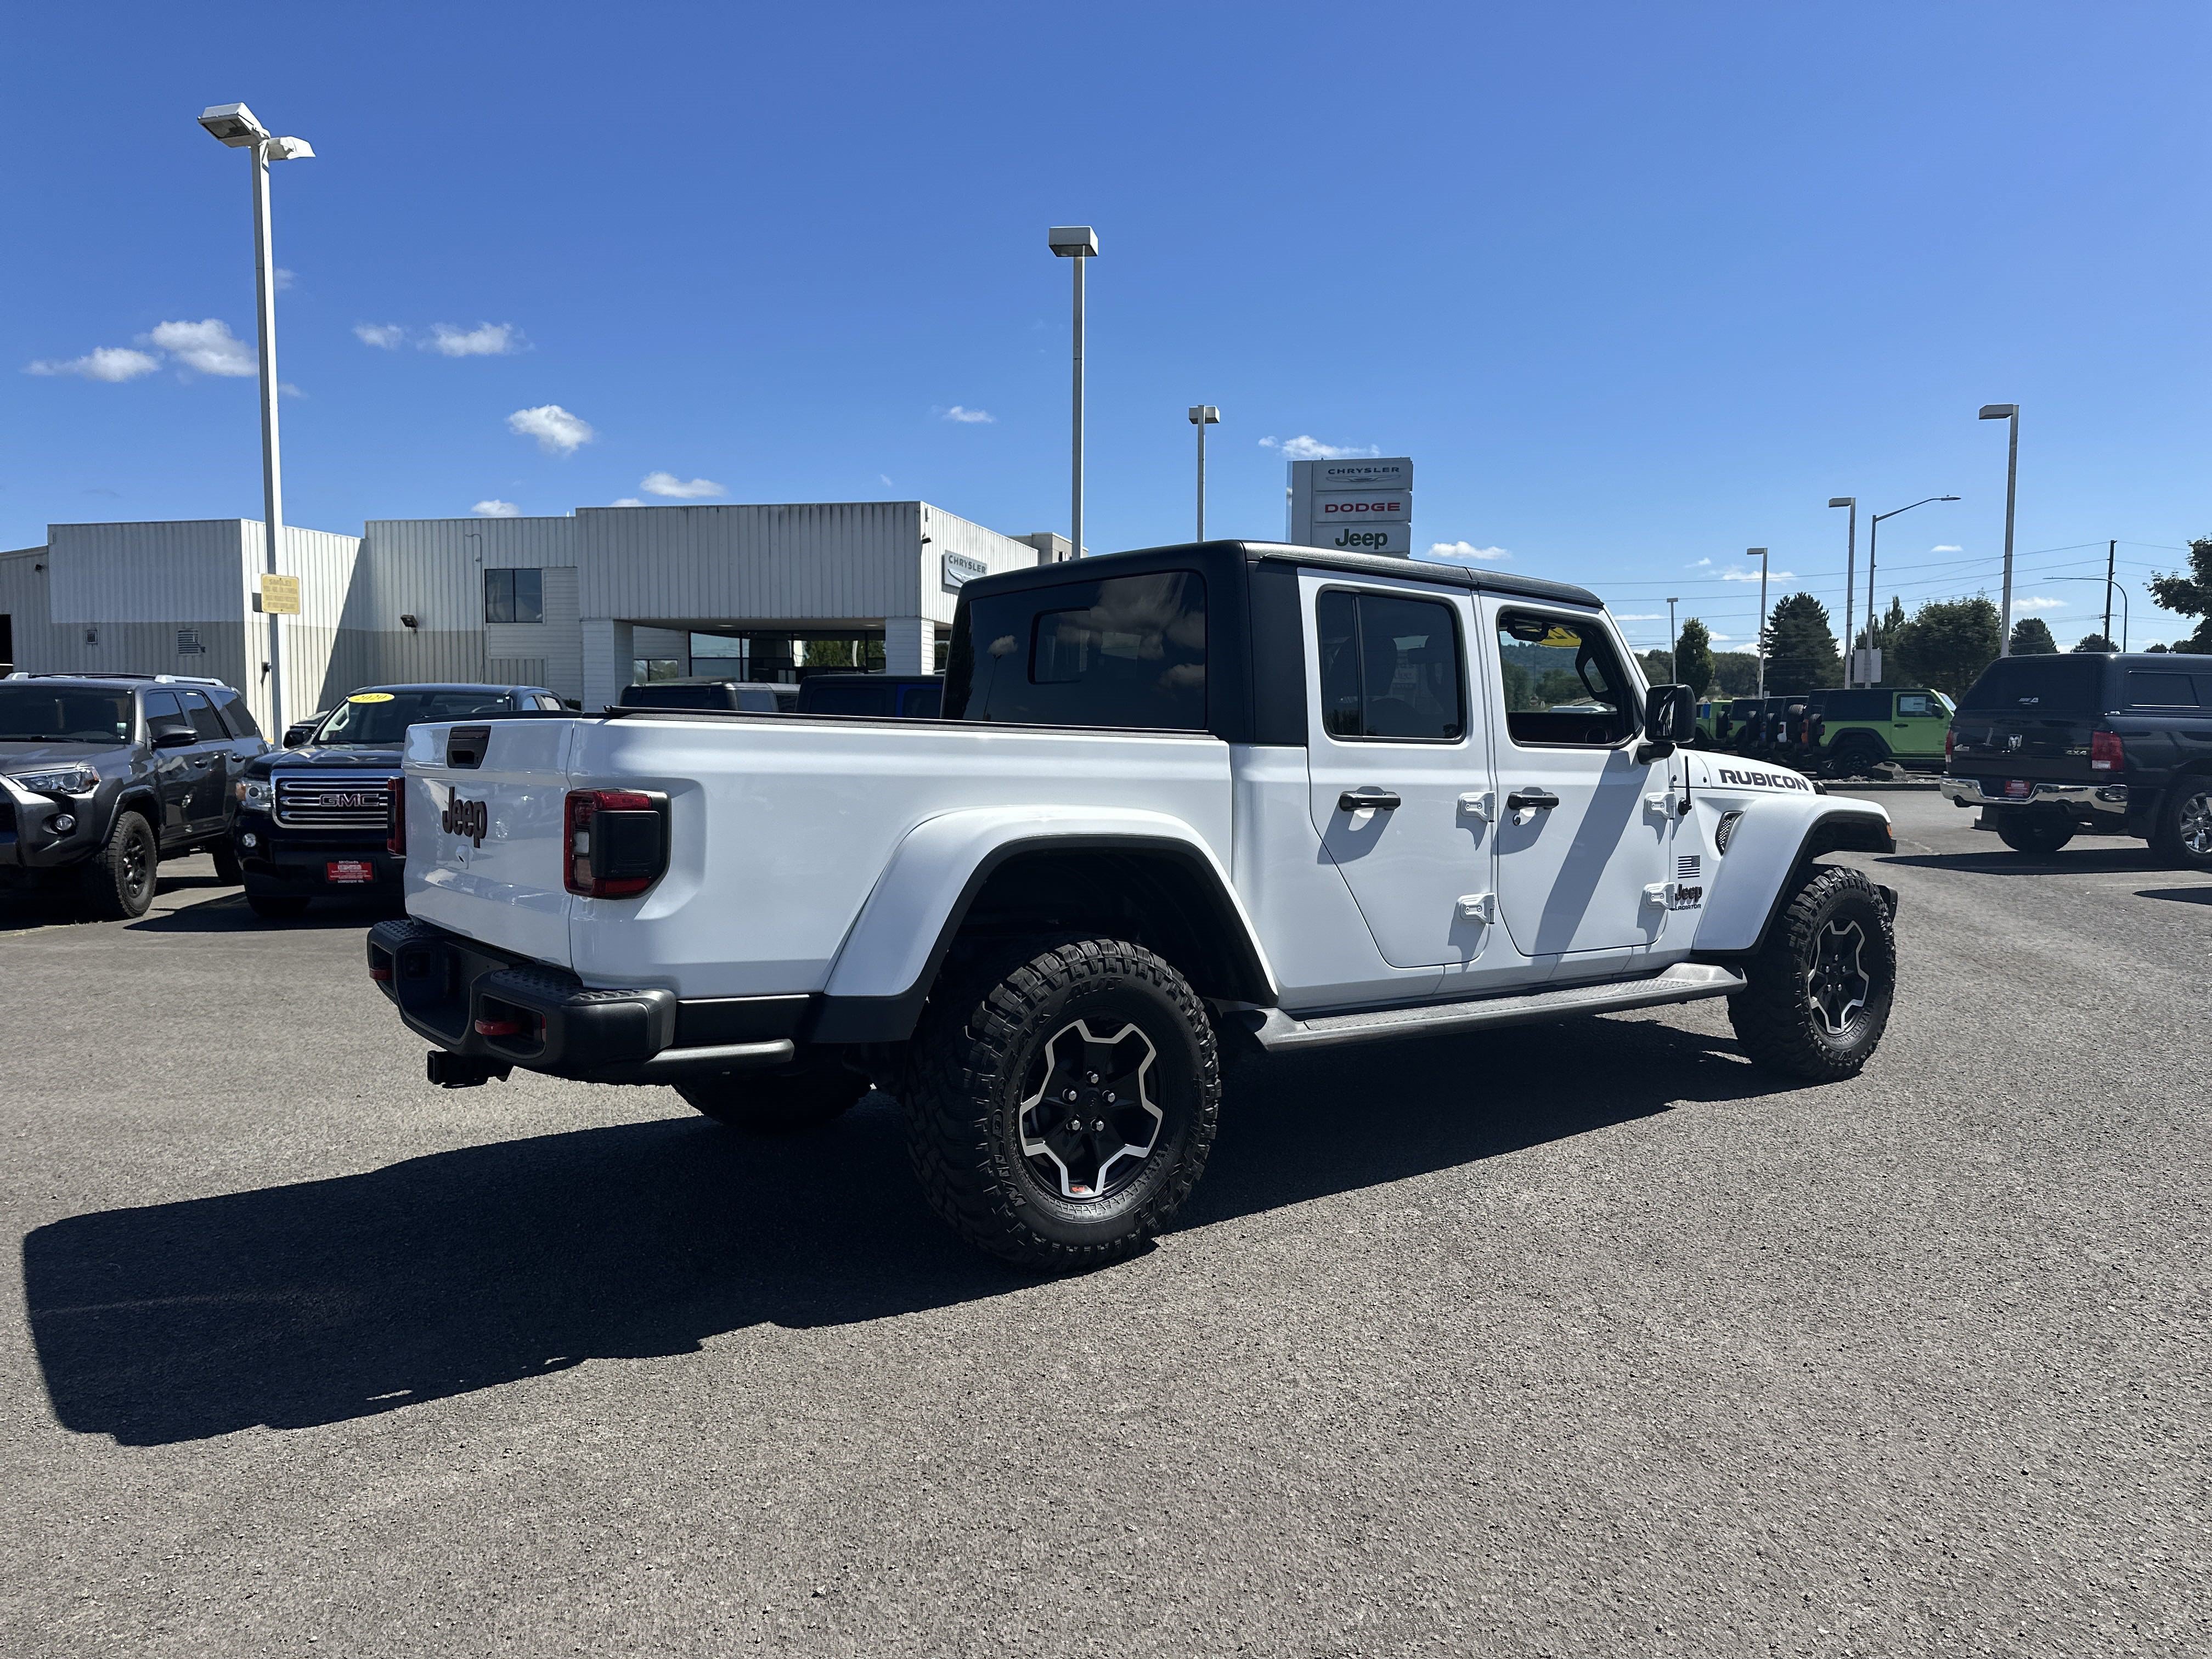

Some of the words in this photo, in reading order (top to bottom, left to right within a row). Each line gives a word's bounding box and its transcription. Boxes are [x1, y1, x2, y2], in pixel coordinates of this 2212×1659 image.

[1325, 503, 1400, 513] DODGE
[1335, 528, 1388, 550] Jeep
[949, 555, 986, 574] CHRYSLER
[1718, 769, 1809, 791] RUBICON
[319, 794, 379, 807] GMC
[442, 786, 488, 849] Jeep
[1674, 883, 1702, 902] Jeep
